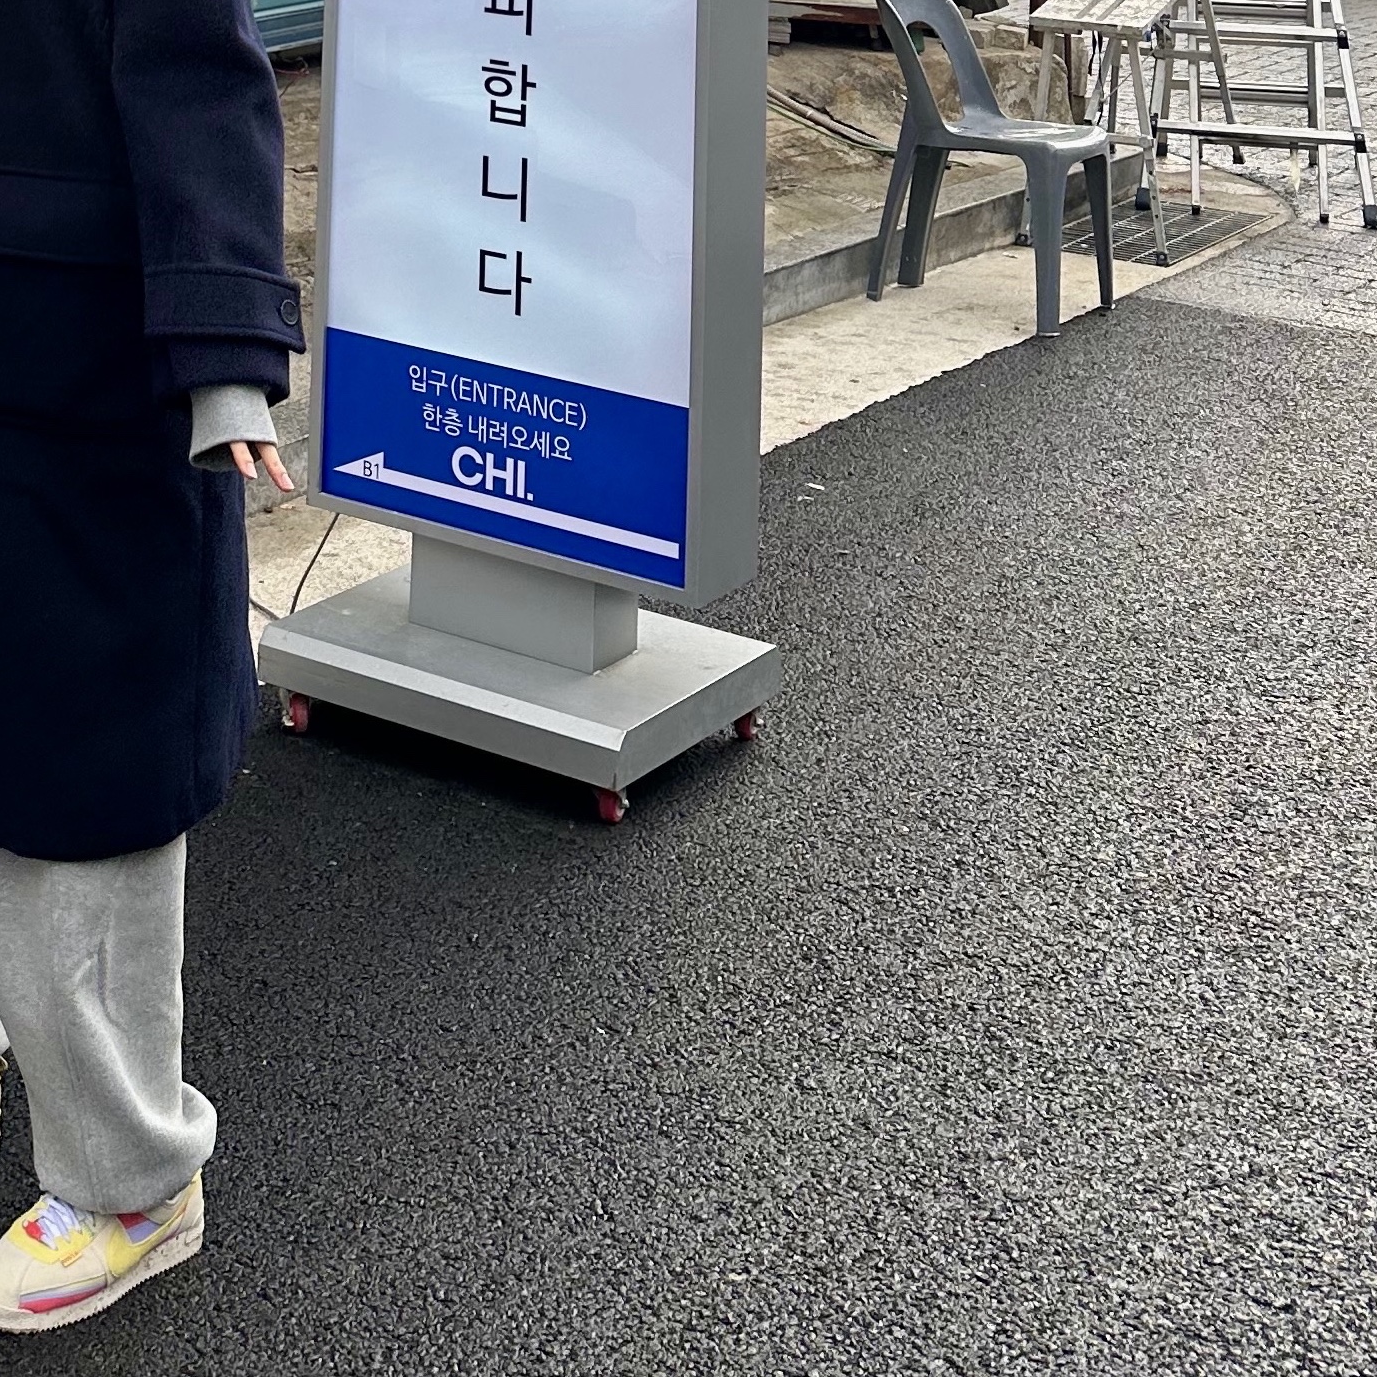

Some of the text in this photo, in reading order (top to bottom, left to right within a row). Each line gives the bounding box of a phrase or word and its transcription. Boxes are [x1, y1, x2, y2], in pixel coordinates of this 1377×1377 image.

[409, 364, 588, 430] 입구(ENTRANCE)
[422, 403, 573, 461] 한층 내려오세요
[363, 460, 381, 480] B1
[451, 445, 535, 502] CHI.
